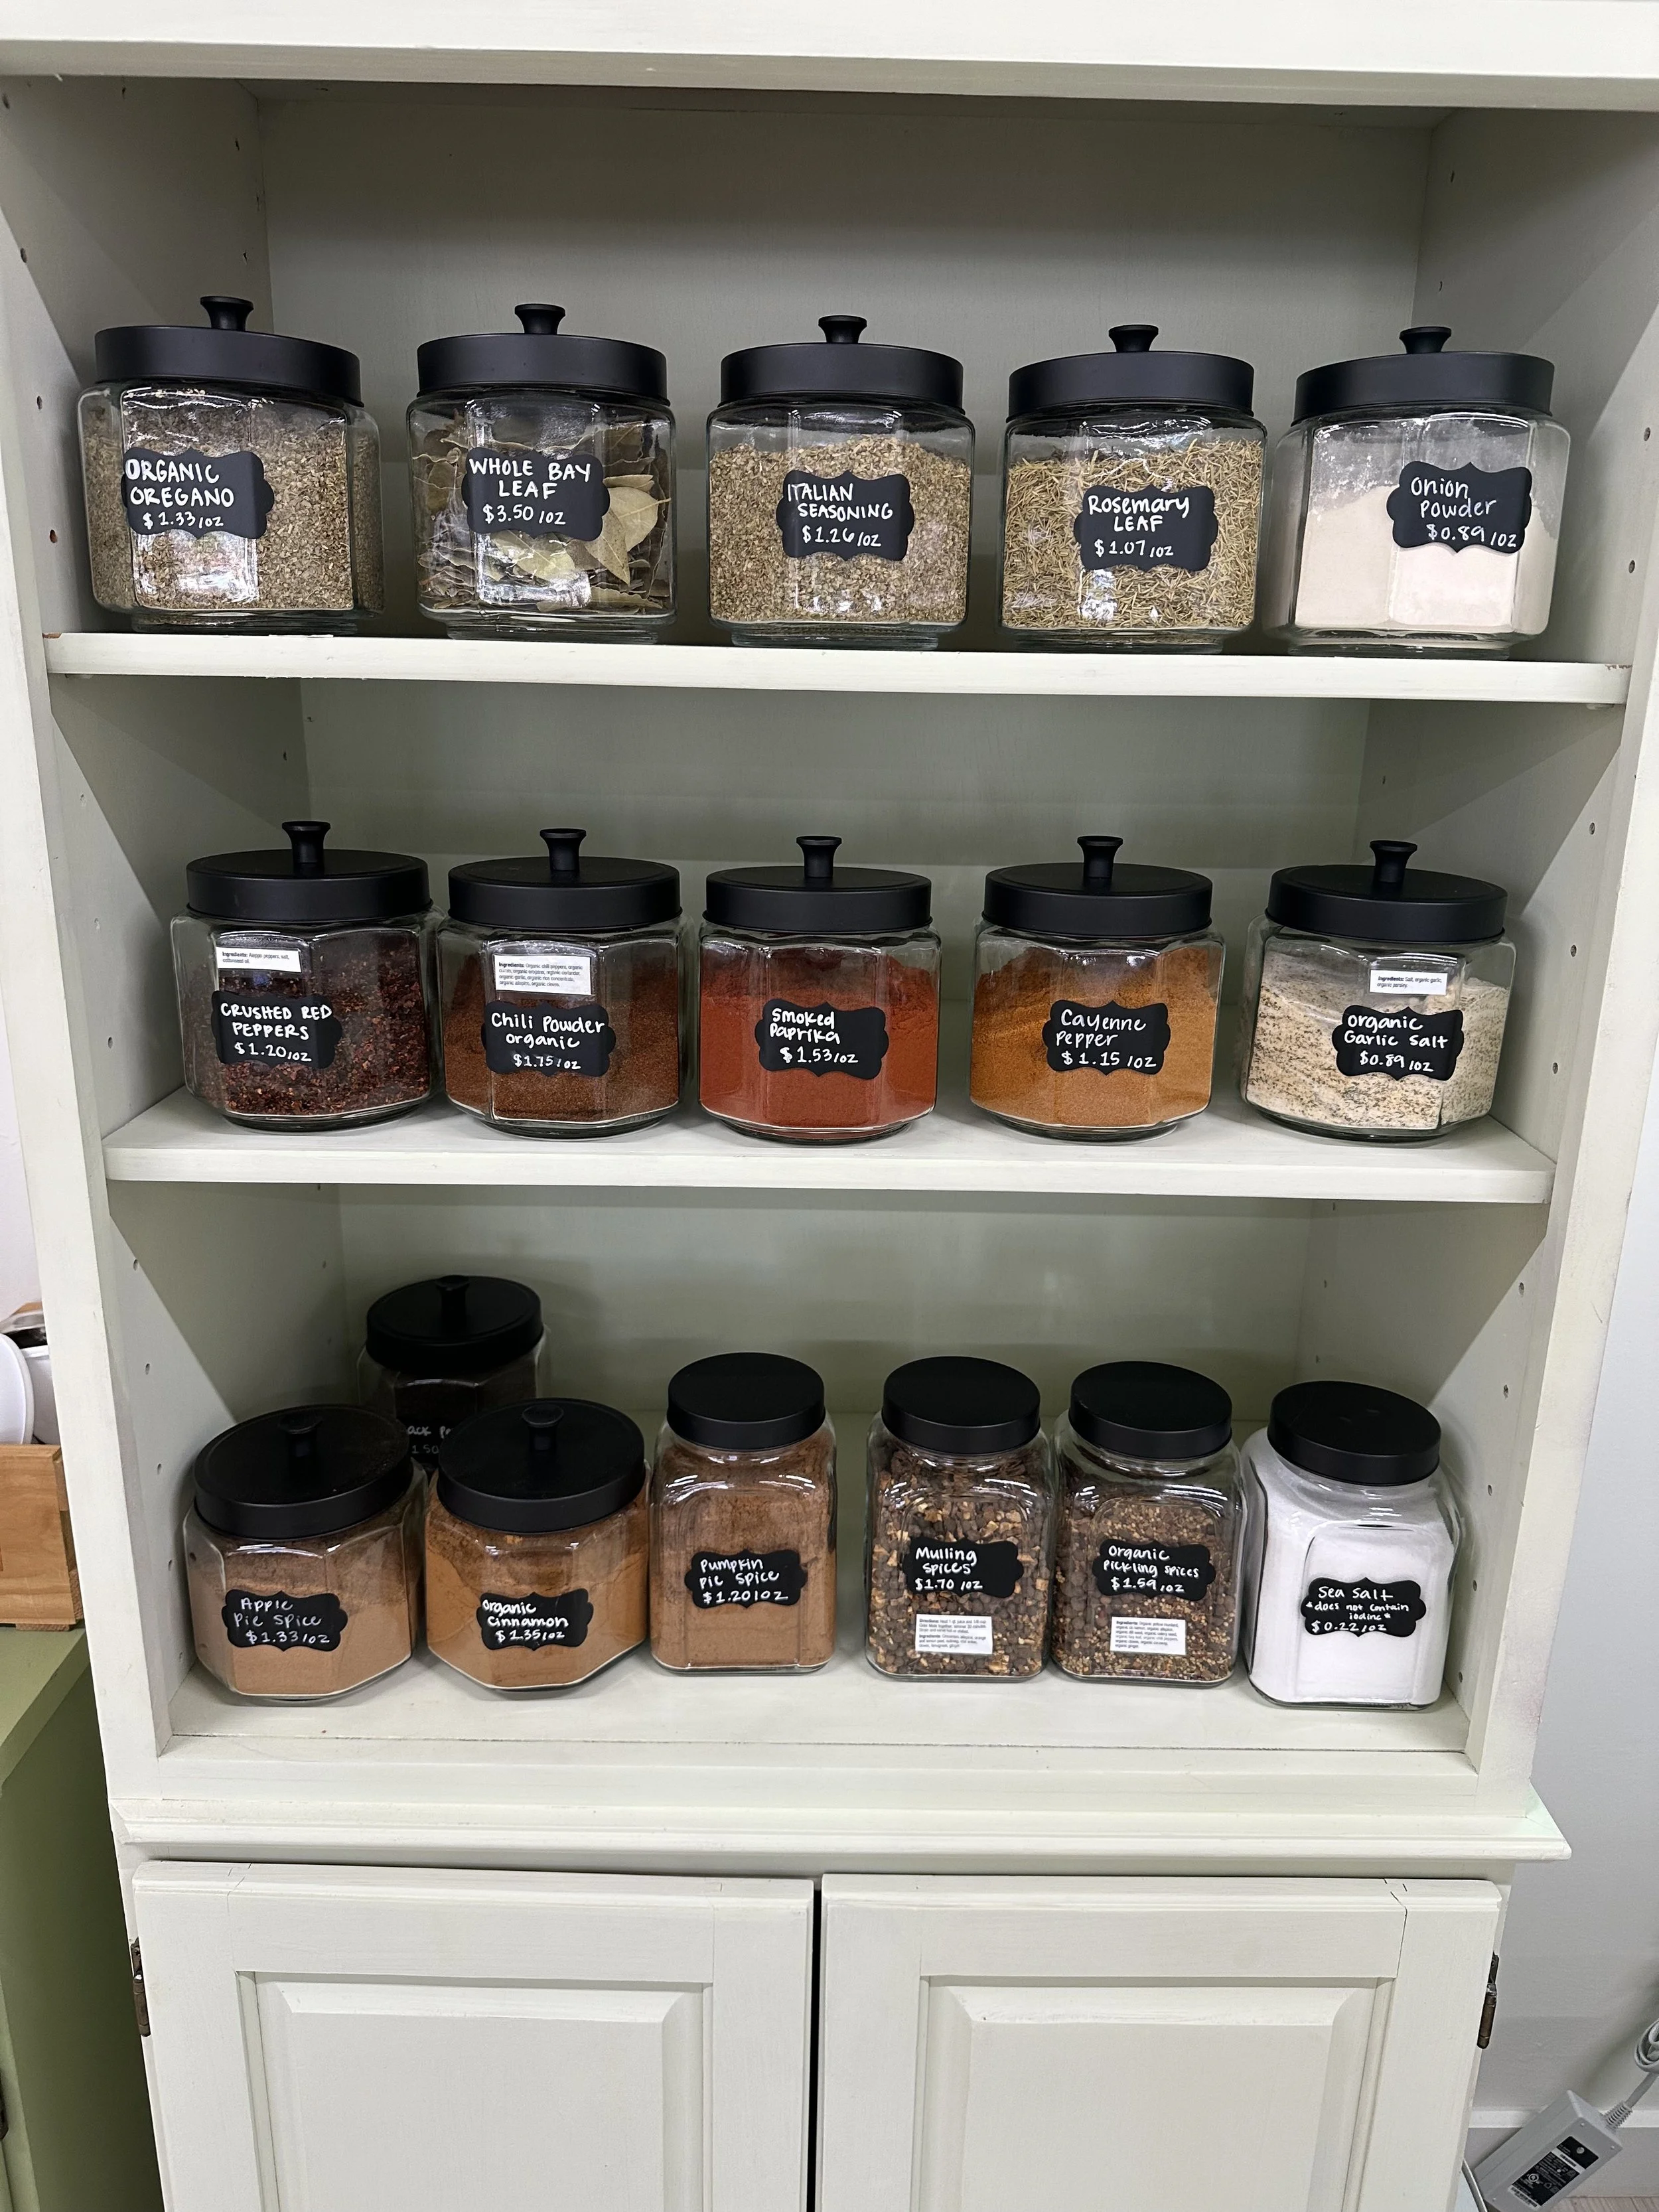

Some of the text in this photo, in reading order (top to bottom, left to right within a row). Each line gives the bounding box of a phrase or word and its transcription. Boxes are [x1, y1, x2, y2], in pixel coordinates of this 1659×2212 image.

[125, 459, 220, 484] ORGANIC
[469, 457, 591, 482] WHOLE BAY
[130, 486, 234, 508] OREGANO
[498, 479, 557, 500] LEAF
[788, 482, 853, 502] ITALIAN
[1411, 477, 1469, 499] Onion
[797, 502, 893, 522] SEASONING
[1088, 495, 1190, 518] Rosemary
[1114, 514, 1163, 532] LEAF
[220, 1002, 332, 1021] CRUSHED RED
[1061, 1009, 1146, 1031] Cayenne
[232, 1021, 309, 1040] PEPPERS
[491, 1012, 605, 1033] Chili Powder
[770, 1023, 840, 1045] Paprika
[1344, 1030, 1398, 1046] Garlic
[407, 1426, 431, 1436] ack
[915, 1546, 977, 1566] Mulling
[1108, 1545, 1170, 1560] Organic
[700, 1559, 763, 1574] Pumpkin
[1103, 1560, 1158, 1578] Pickling
[1318, 1586, 1344, 1599] Sea
[240, 1597, 293, 1612] Apple
